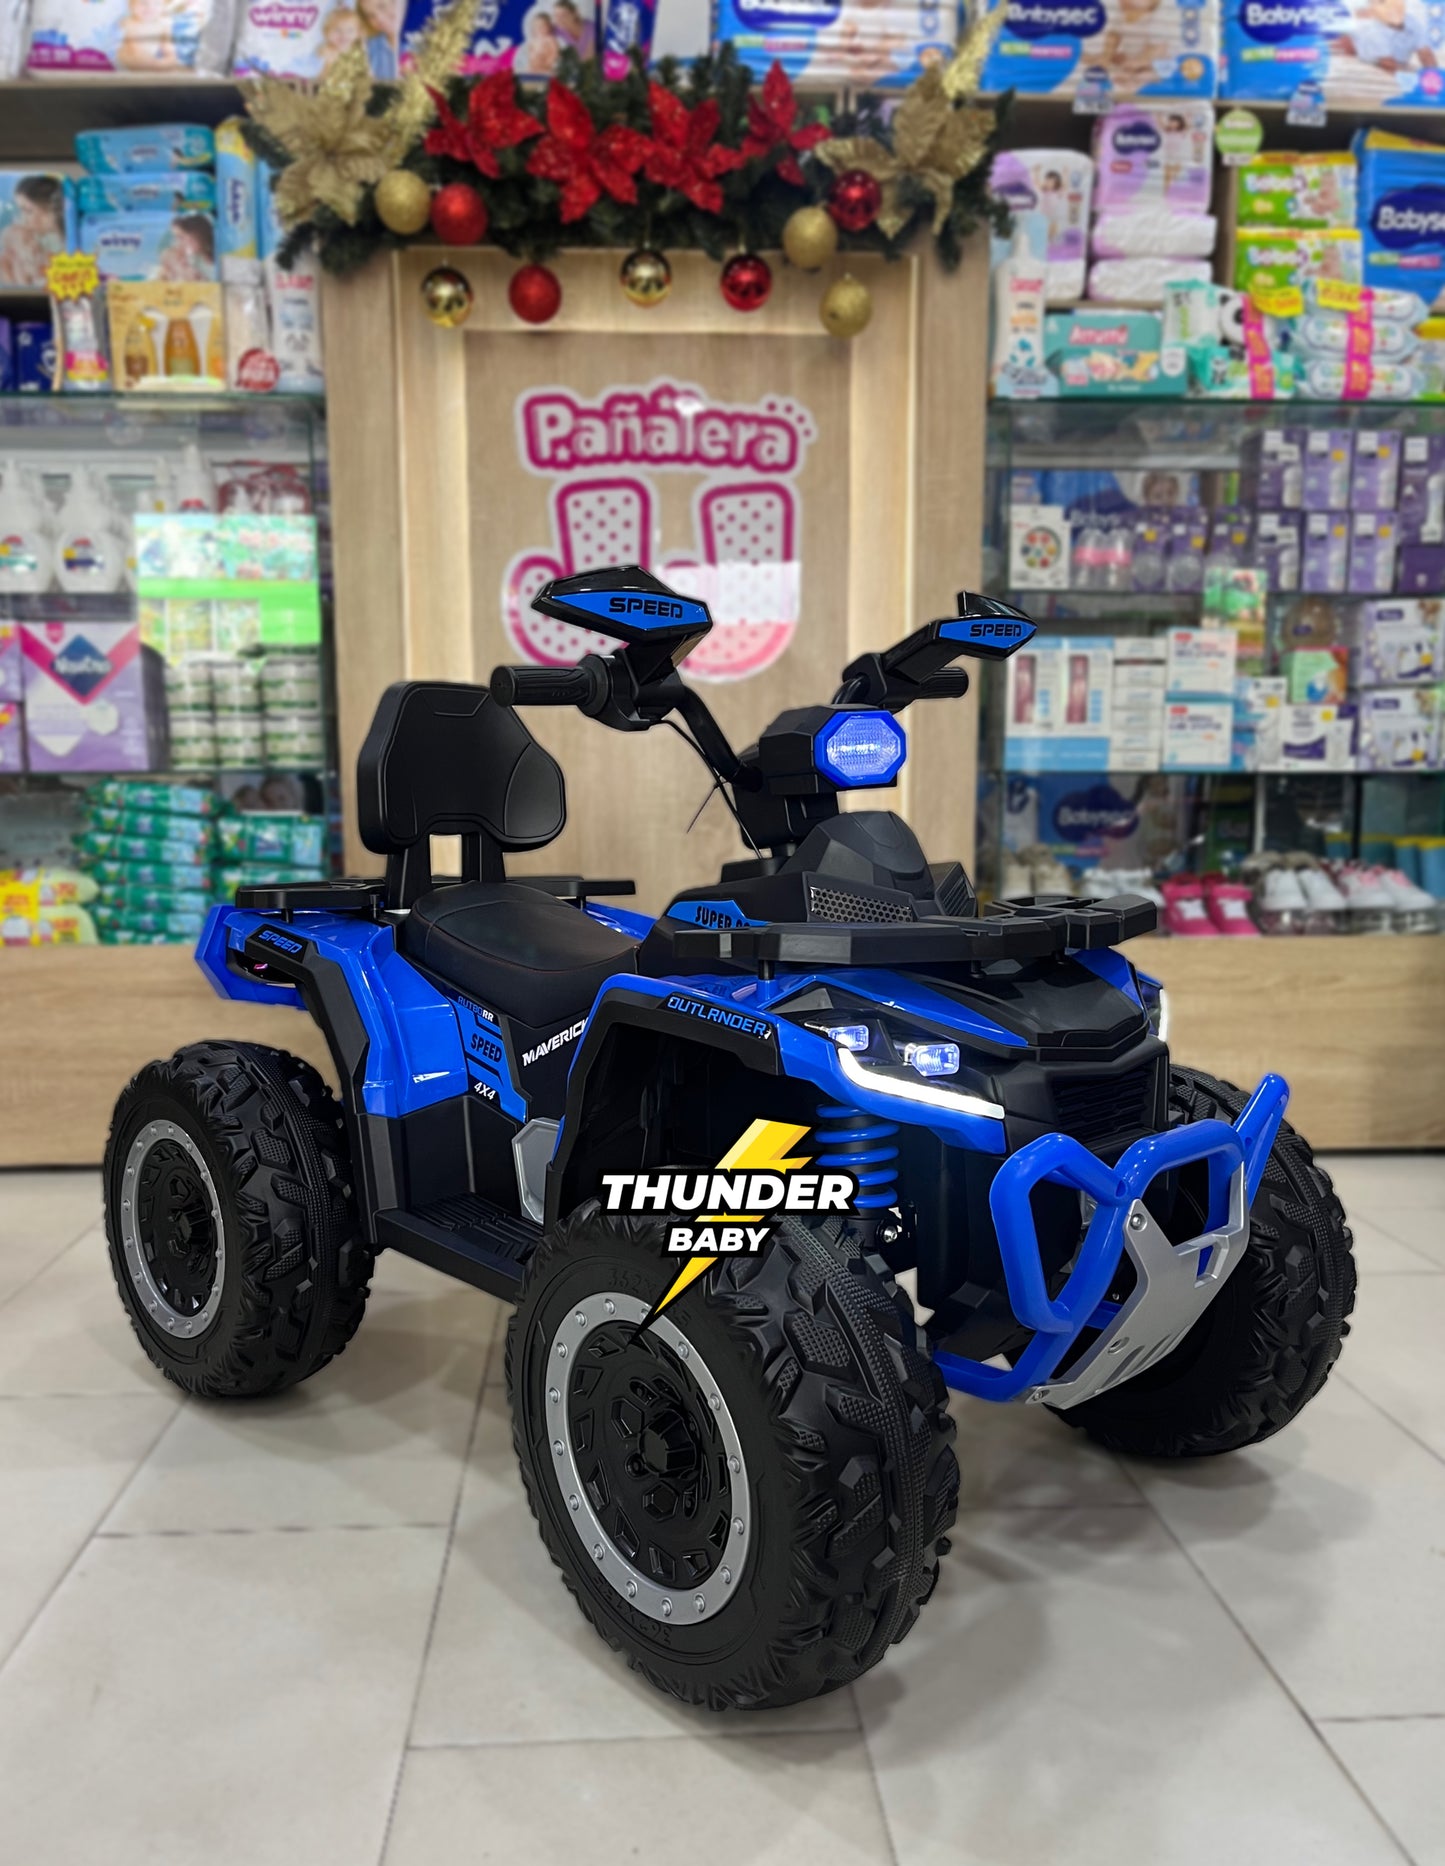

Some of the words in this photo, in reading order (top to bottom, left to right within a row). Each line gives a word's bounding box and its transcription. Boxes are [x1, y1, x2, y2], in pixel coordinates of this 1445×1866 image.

[527, 393, 793, 470] Pañalera
[609, 597, 683, 619] SPEED
[969, 622, 1022, 639] SPEED
[695, 905, 732, 929] SUPER
[258, 929, 303, 954] SPEED
[470, 1033, 502, 1063] SPEED
